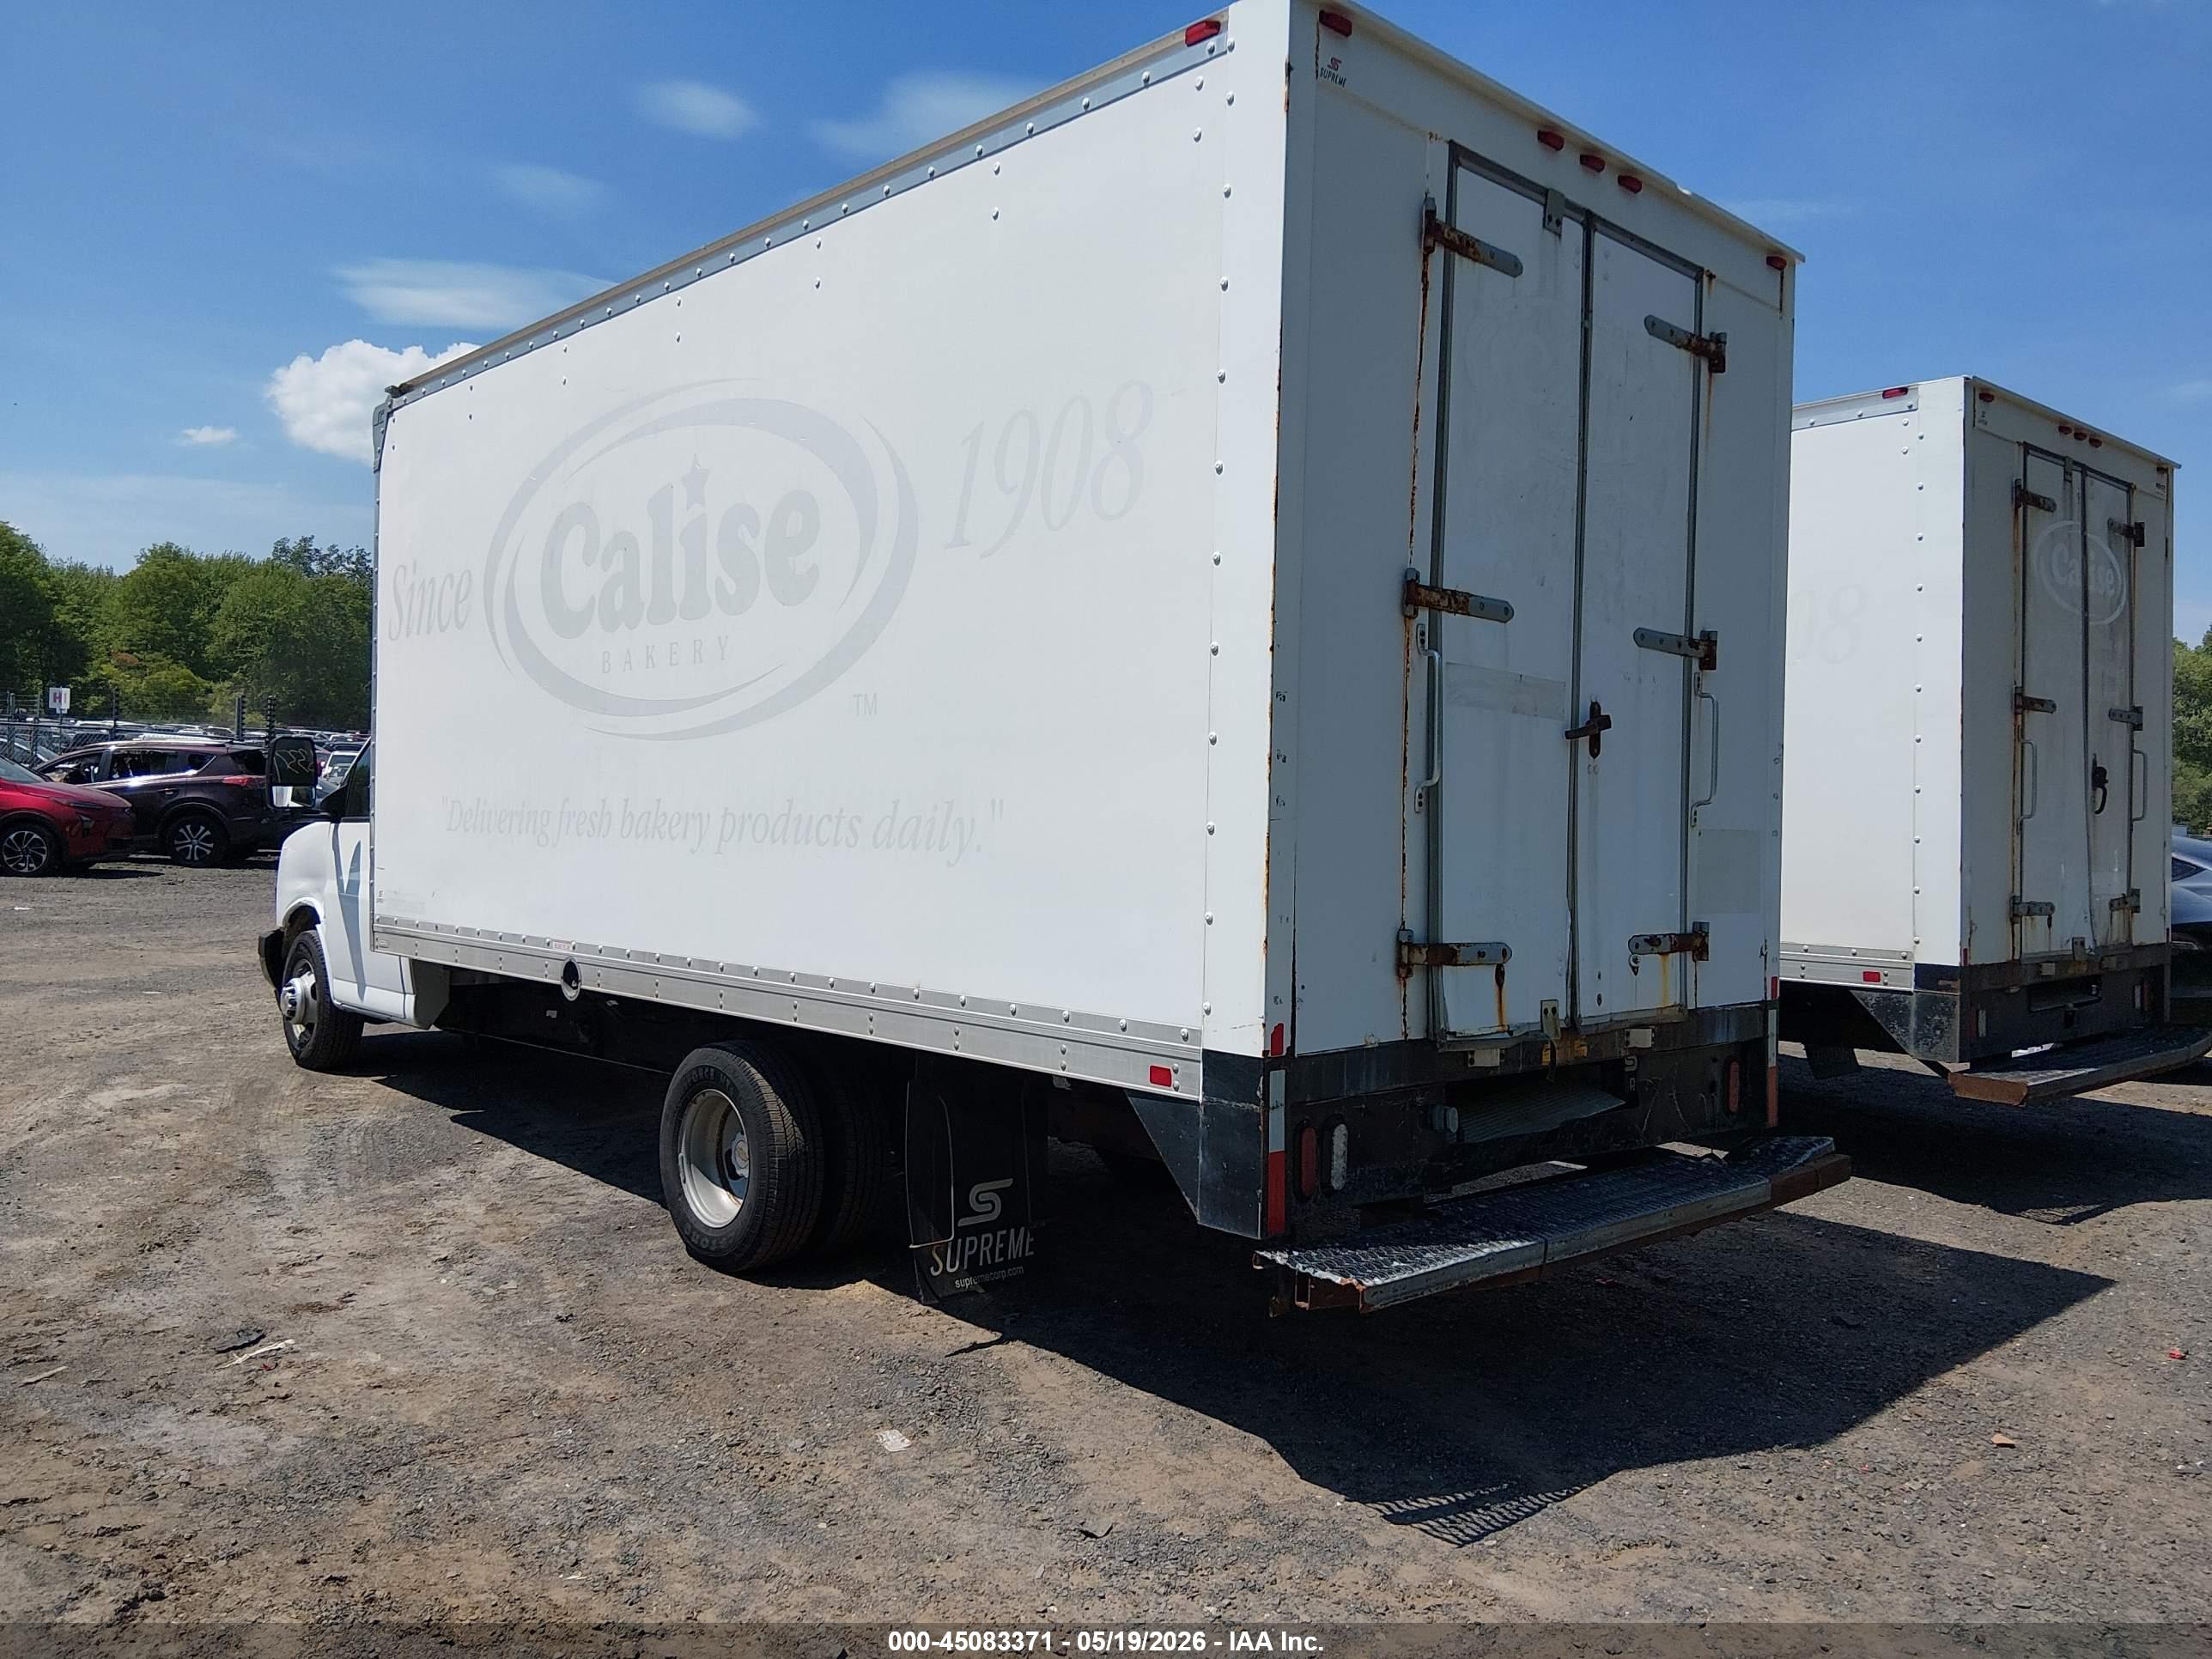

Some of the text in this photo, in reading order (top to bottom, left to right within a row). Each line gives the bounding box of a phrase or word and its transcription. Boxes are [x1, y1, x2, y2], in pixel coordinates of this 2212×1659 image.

[1320, 67, 1346, 88] SUPREME
[945, 379, 1153, 558] 1908
[541, 455, 820, 640] Calise
[388, 559, 472, 643] Since
[602, 635, 732, 675] BAKERY
[853, 693, 878, 716] TM
[552, 795, 612, 848] fresh
[620, 796, 711, 854] bakery
[714, 797, 862, 854] products
[930, 1226, 1035, 1277] SUPREME
[955, 1265, 1024, 1289] supremecorp.com
